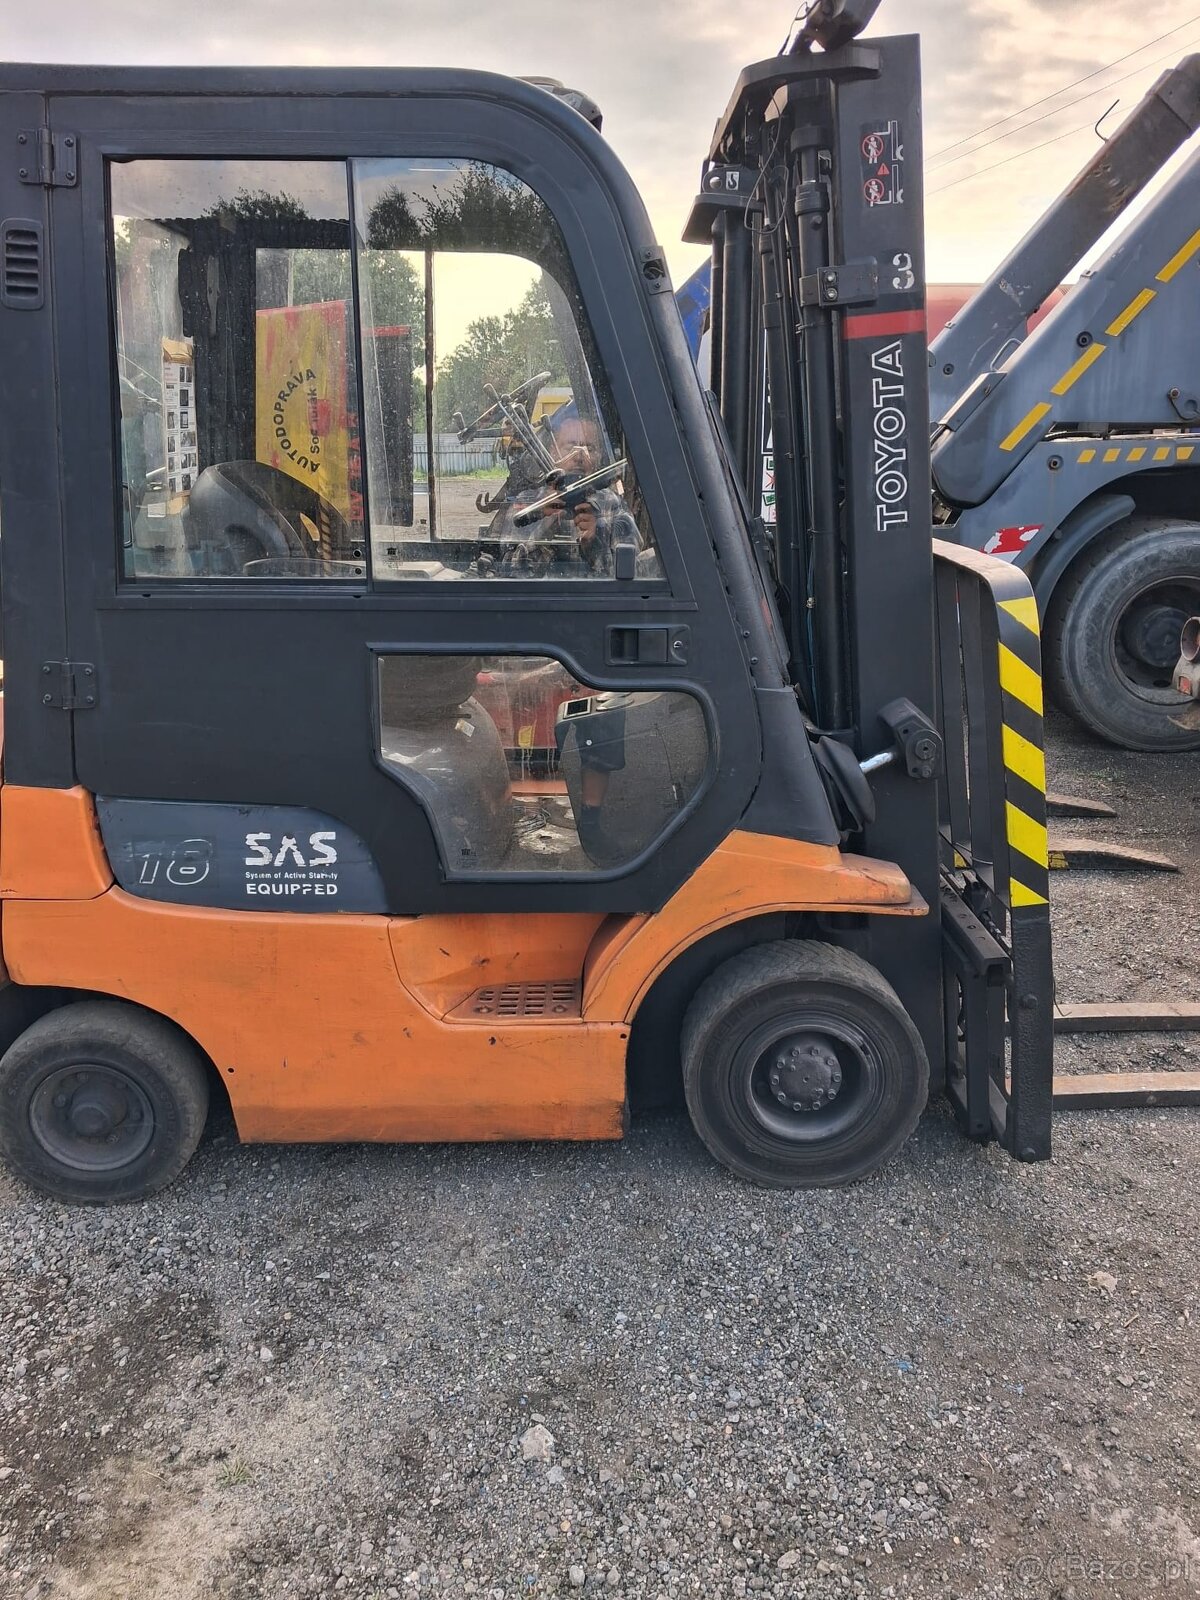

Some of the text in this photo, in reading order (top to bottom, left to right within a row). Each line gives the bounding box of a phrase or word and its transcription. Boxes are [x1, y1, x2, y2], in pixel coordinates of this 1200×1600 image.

[892, 252, 915, 290] 3
[273, 368, 321, 473] AUTODOPRAVA
[871, 339, 908, 531] TOYOTA
[138, 838, 213, 886] 18
[245, 831, 338, 866] SAS
[245, 883, 338, 895] EQUIPPED
[274, 871, 281, 879] of
[284, 871, 306, 879] Active
